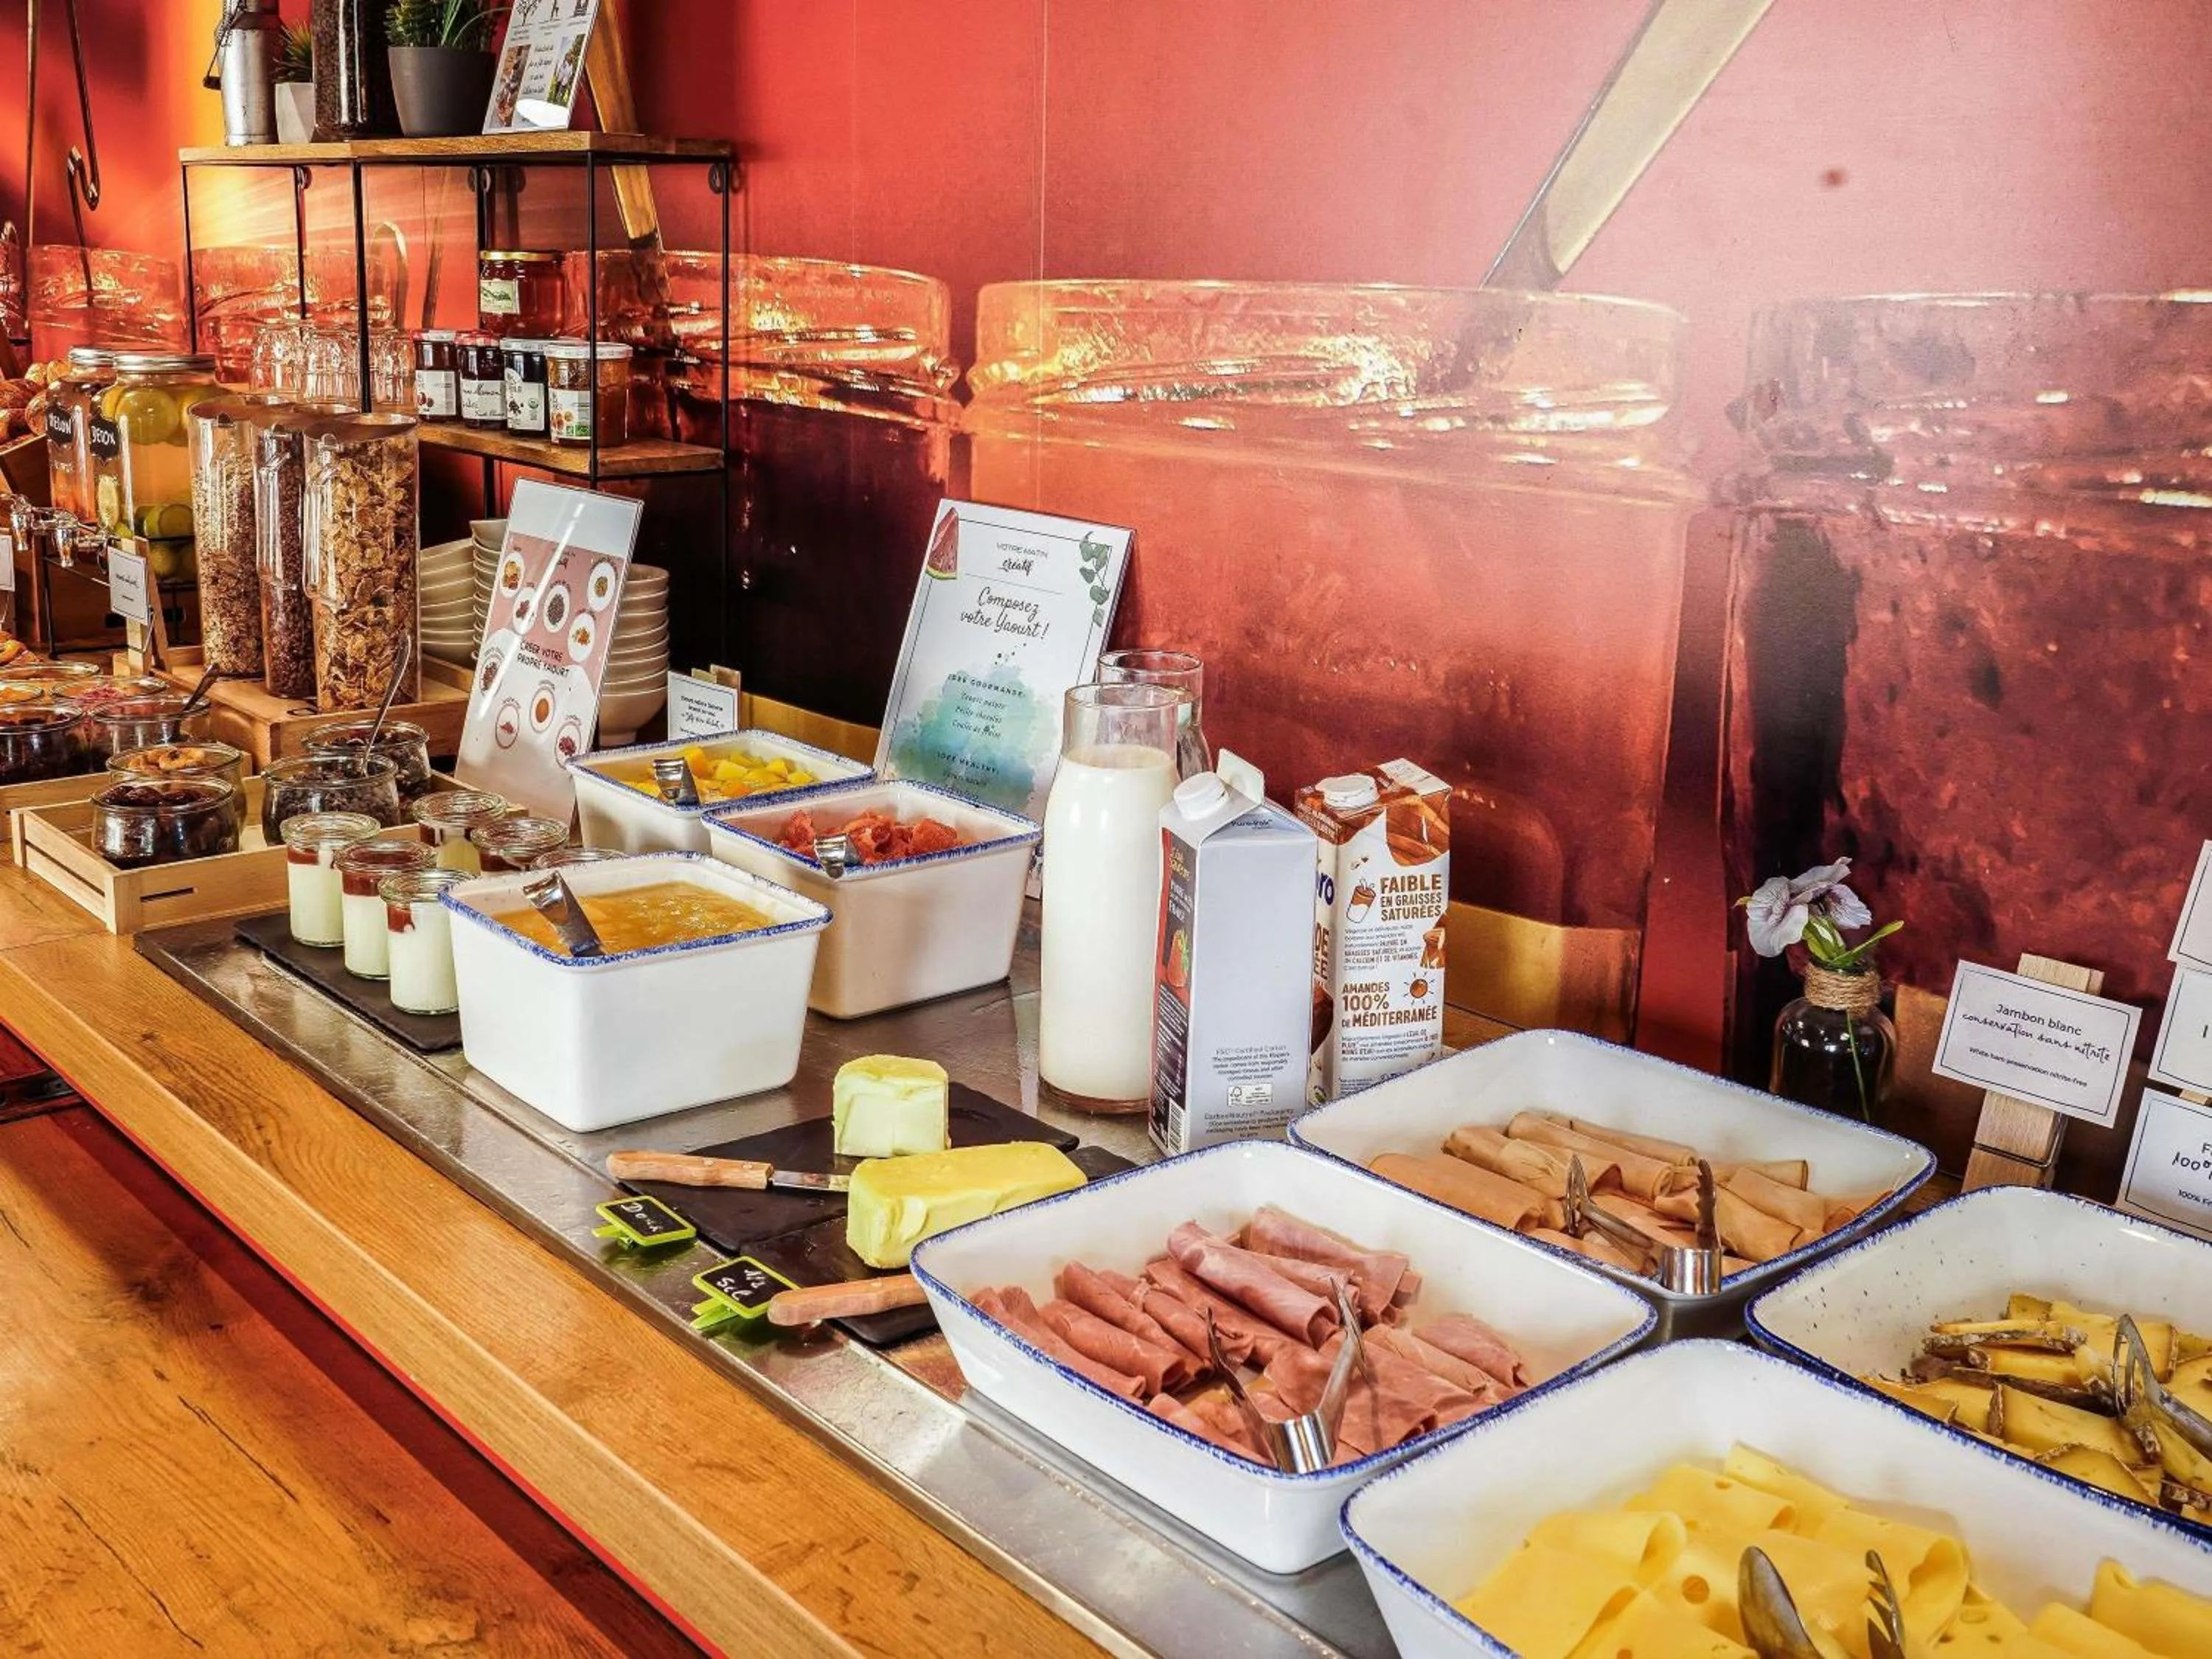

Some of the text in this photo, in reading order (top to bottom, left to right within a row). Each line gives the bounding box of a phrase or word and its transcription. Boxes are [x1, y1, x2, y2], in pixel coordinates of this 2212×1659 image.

[978, 586, 1040, 623] Composez
[961, 608, 993, 627] votre
[993, 606, 1044, 638] Yaourt
[517, 653, 542, 669] PROPRE
[543, 663, 570, 677] YAOURT
[542, 648, 564, 662] VOTRE
[1380, 874, 1442, 894] FAIBLE
[1381, 892, 1442, 908] EN GRAISSES
[1381, 904, 1441, 922] SATURÉES
[1342, 981, 1390, 994] AMANDES
[1342, 993, 1390, 1012] 100%
[1341, 1005, 1438, 1028] DE MÉDITERRANÉE
[1995, 1004, 2082, 1036] Jambon blanc
[1961, 1013, 2034, 1039] conservation
[2037, 1033, 2073, 1048] sans
[1969, 1046, 1989, 1058] White
[2006, 1058, 2049, 1077] preservation
[2177, 1189, 2201, 1203] 100%
